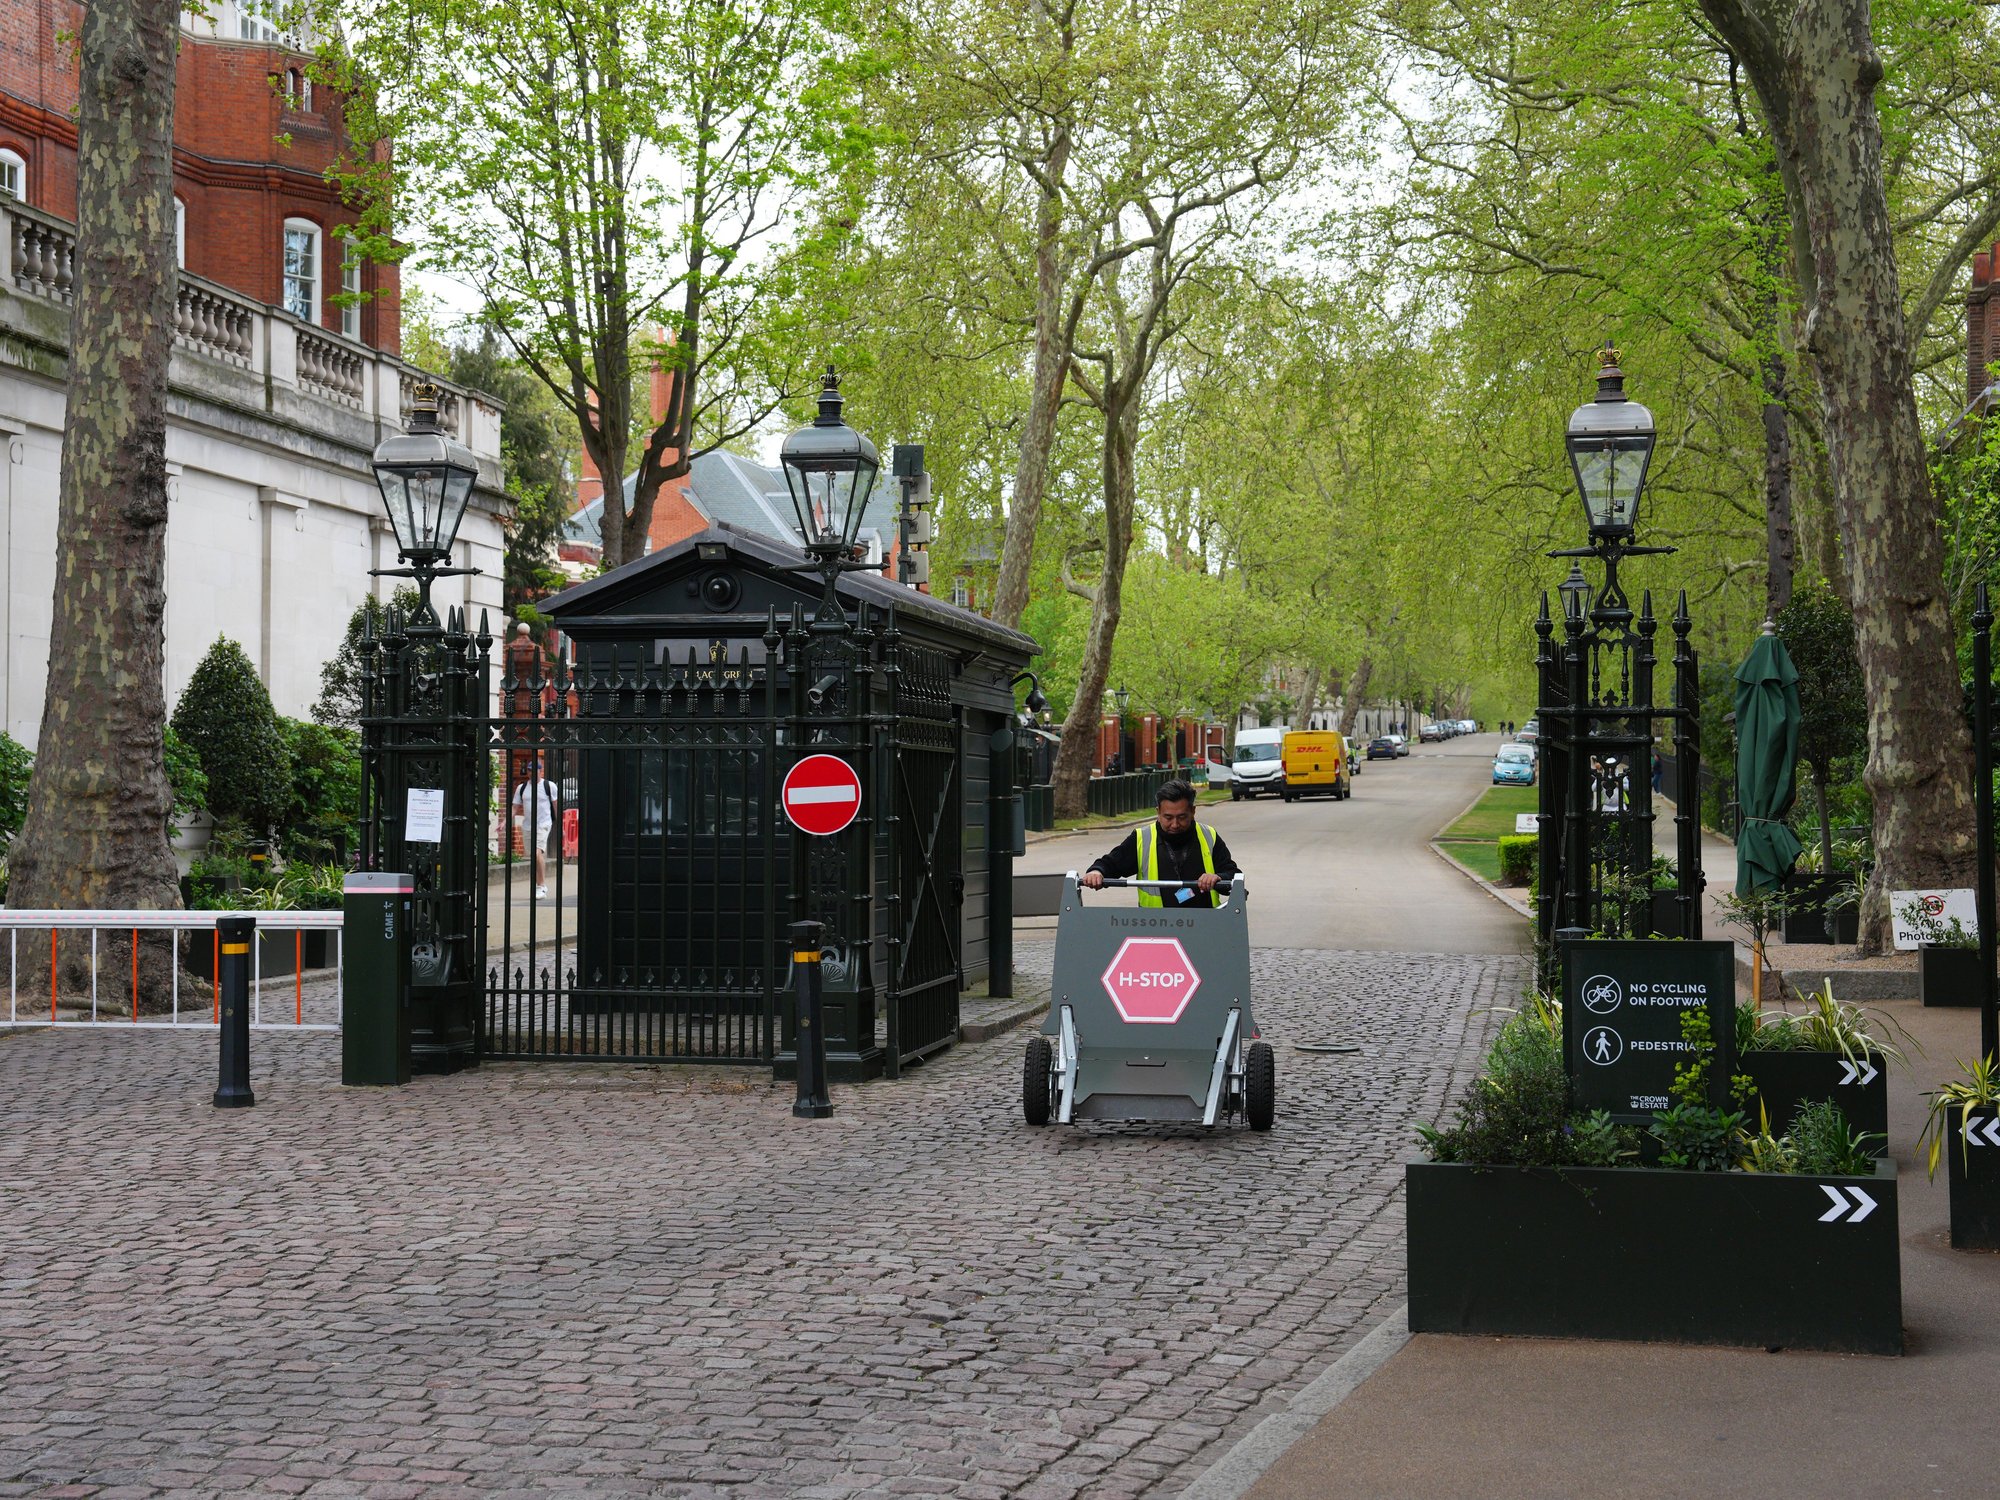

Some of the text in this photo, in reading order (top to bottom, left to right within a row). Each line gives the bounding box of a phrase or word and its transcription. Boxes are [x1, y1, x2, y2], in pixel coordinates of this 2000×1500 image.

[685, 671, 718, 679] PLAC
[384, 912, 394, 939] CAME
[1110, 915, 1195, 928] husson.eu
[1119, 971, 1185, 988] H-STOP
[1630, 983, 1707, 994] NO CYCLING
[1629, 997, 1707, 1007] ON FOOTWAY
[1630, 1041, 1713, 1052] PEDESTRIA
[1639, 1095, 1669, 1103] CROWN
